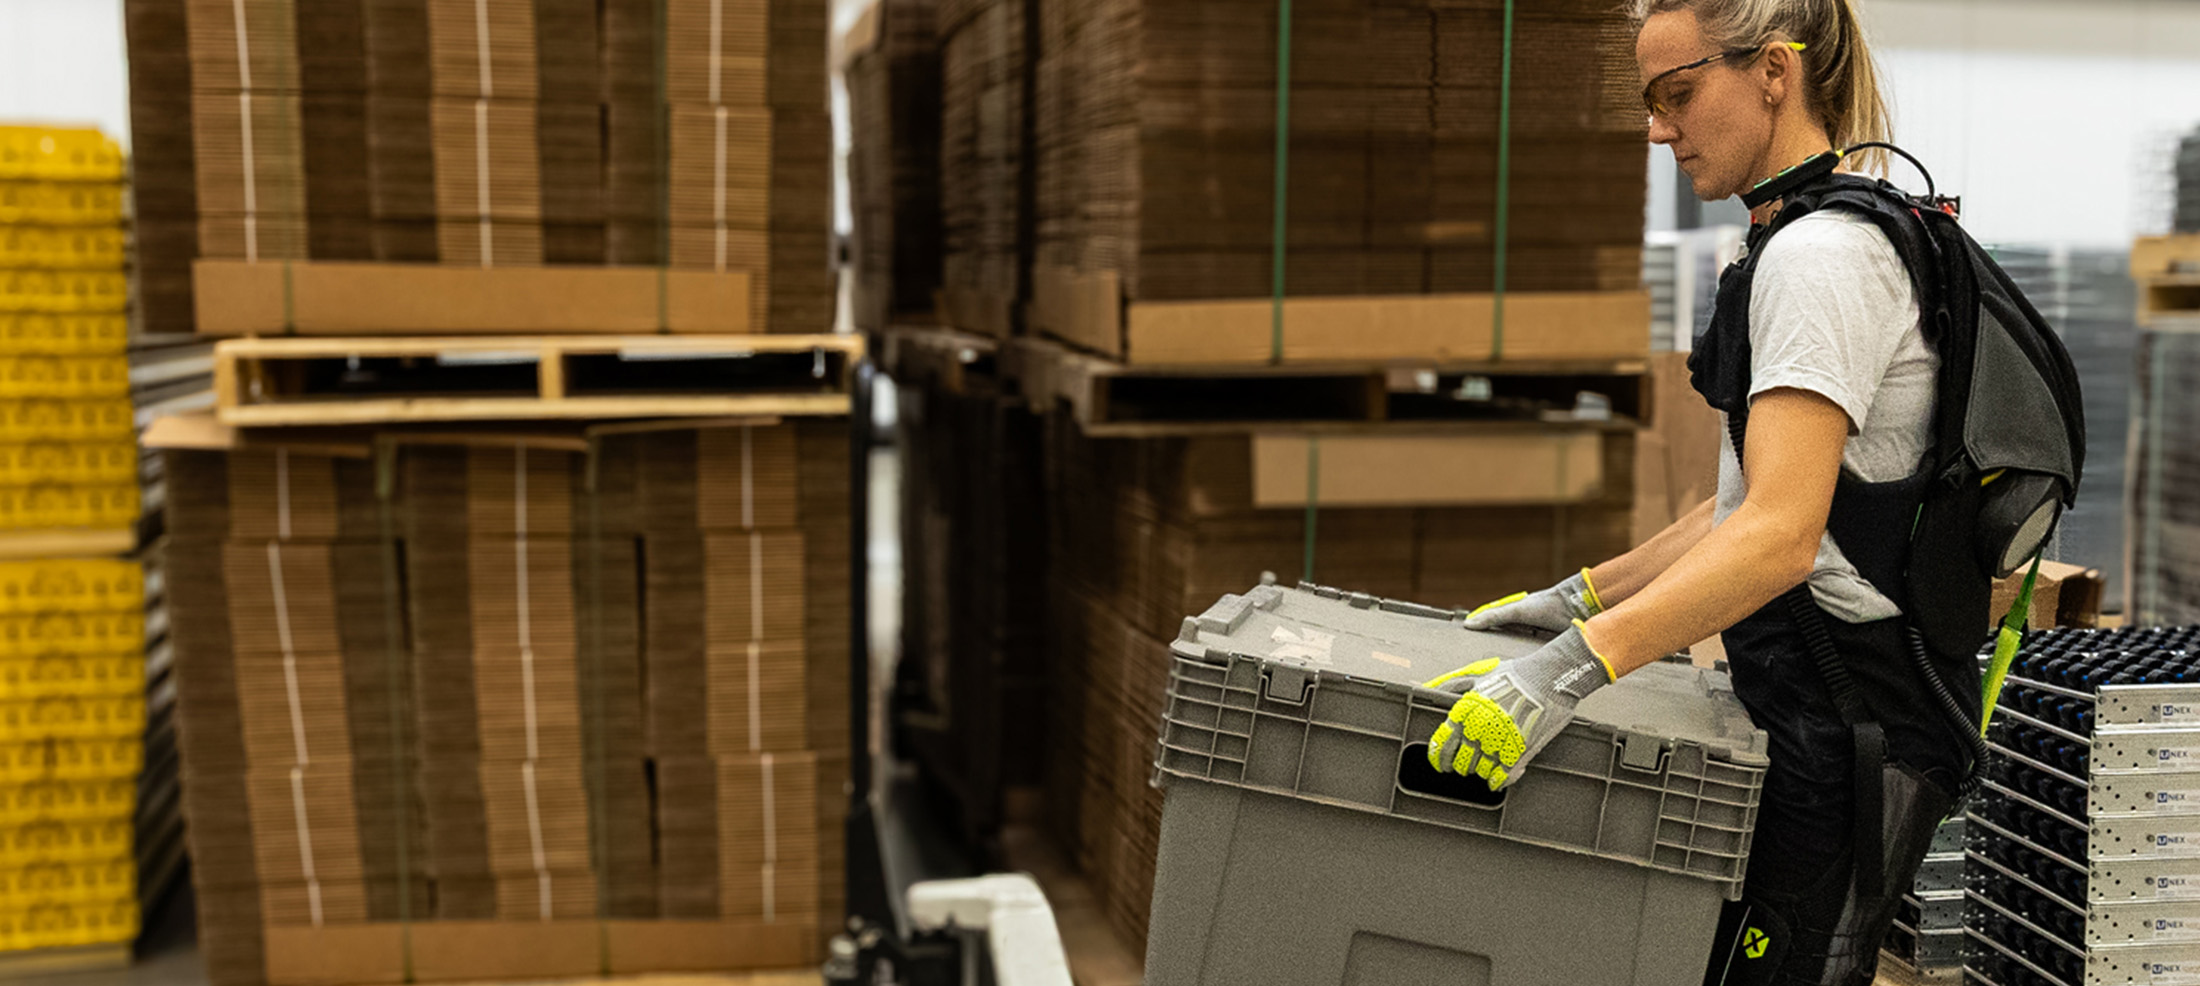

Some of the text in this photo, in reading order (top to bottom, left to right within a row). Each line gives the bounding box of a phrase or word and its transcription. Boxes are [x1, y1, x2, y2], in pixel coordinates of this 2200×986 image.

[2163, 705, 2192, 715] UNEX
[2159, 749, 2188, 760] UNEX
[2157, 792, 2186, 803] UNEX
[2157, 835, 2185, 846] UNEX
[2158, 878, 2186, 888] UNEX
[2156, 920, 2184, 930] UNEX
[2152, 964, 2181, 974] UNEX
